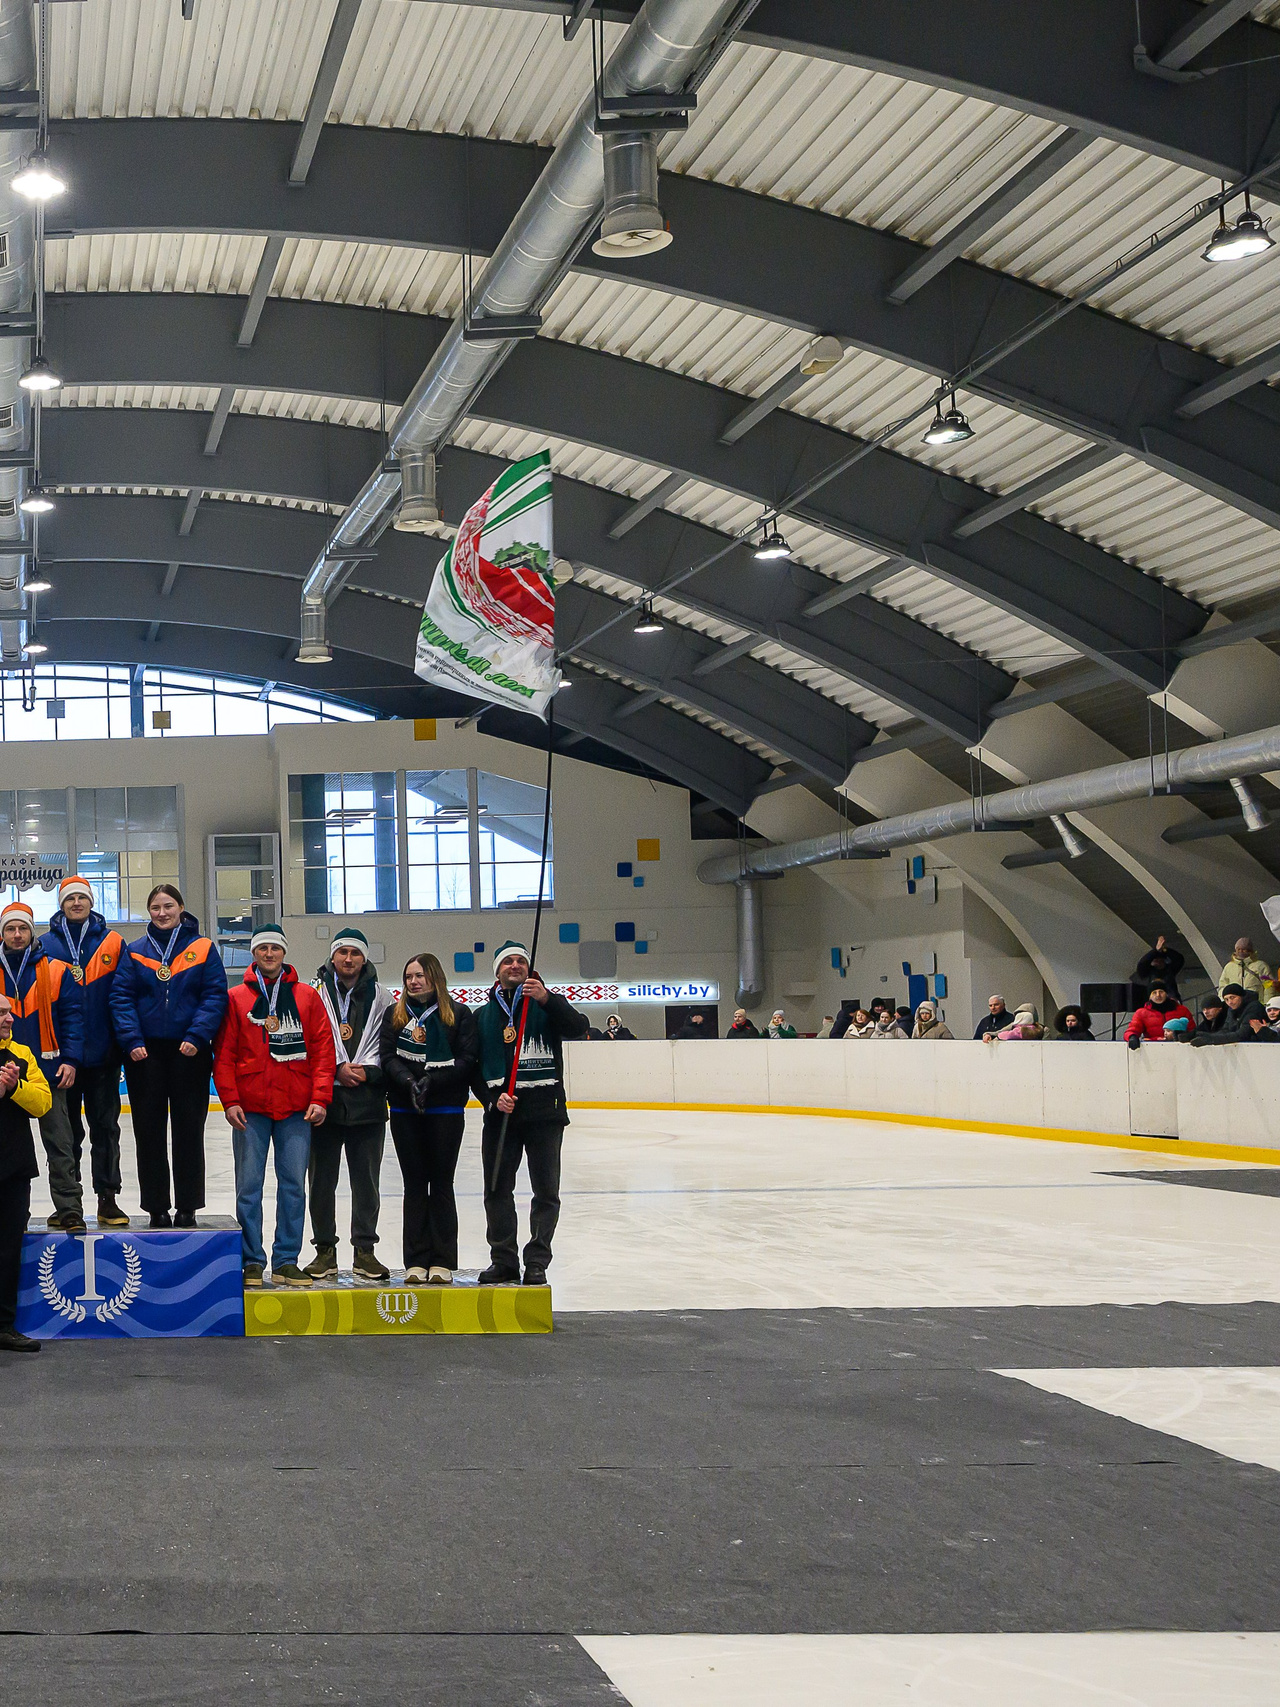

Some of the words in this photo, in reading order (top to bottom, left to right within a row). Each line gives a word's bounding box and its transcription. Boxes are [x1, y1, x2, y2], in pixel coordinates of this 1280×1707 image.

[1, 857, 37, 867] КАФЕ
[628, 984, 710, 998] silichy.by
[73, 1234, 106, 1301] I
[382, 1293, 411, 1312] III
